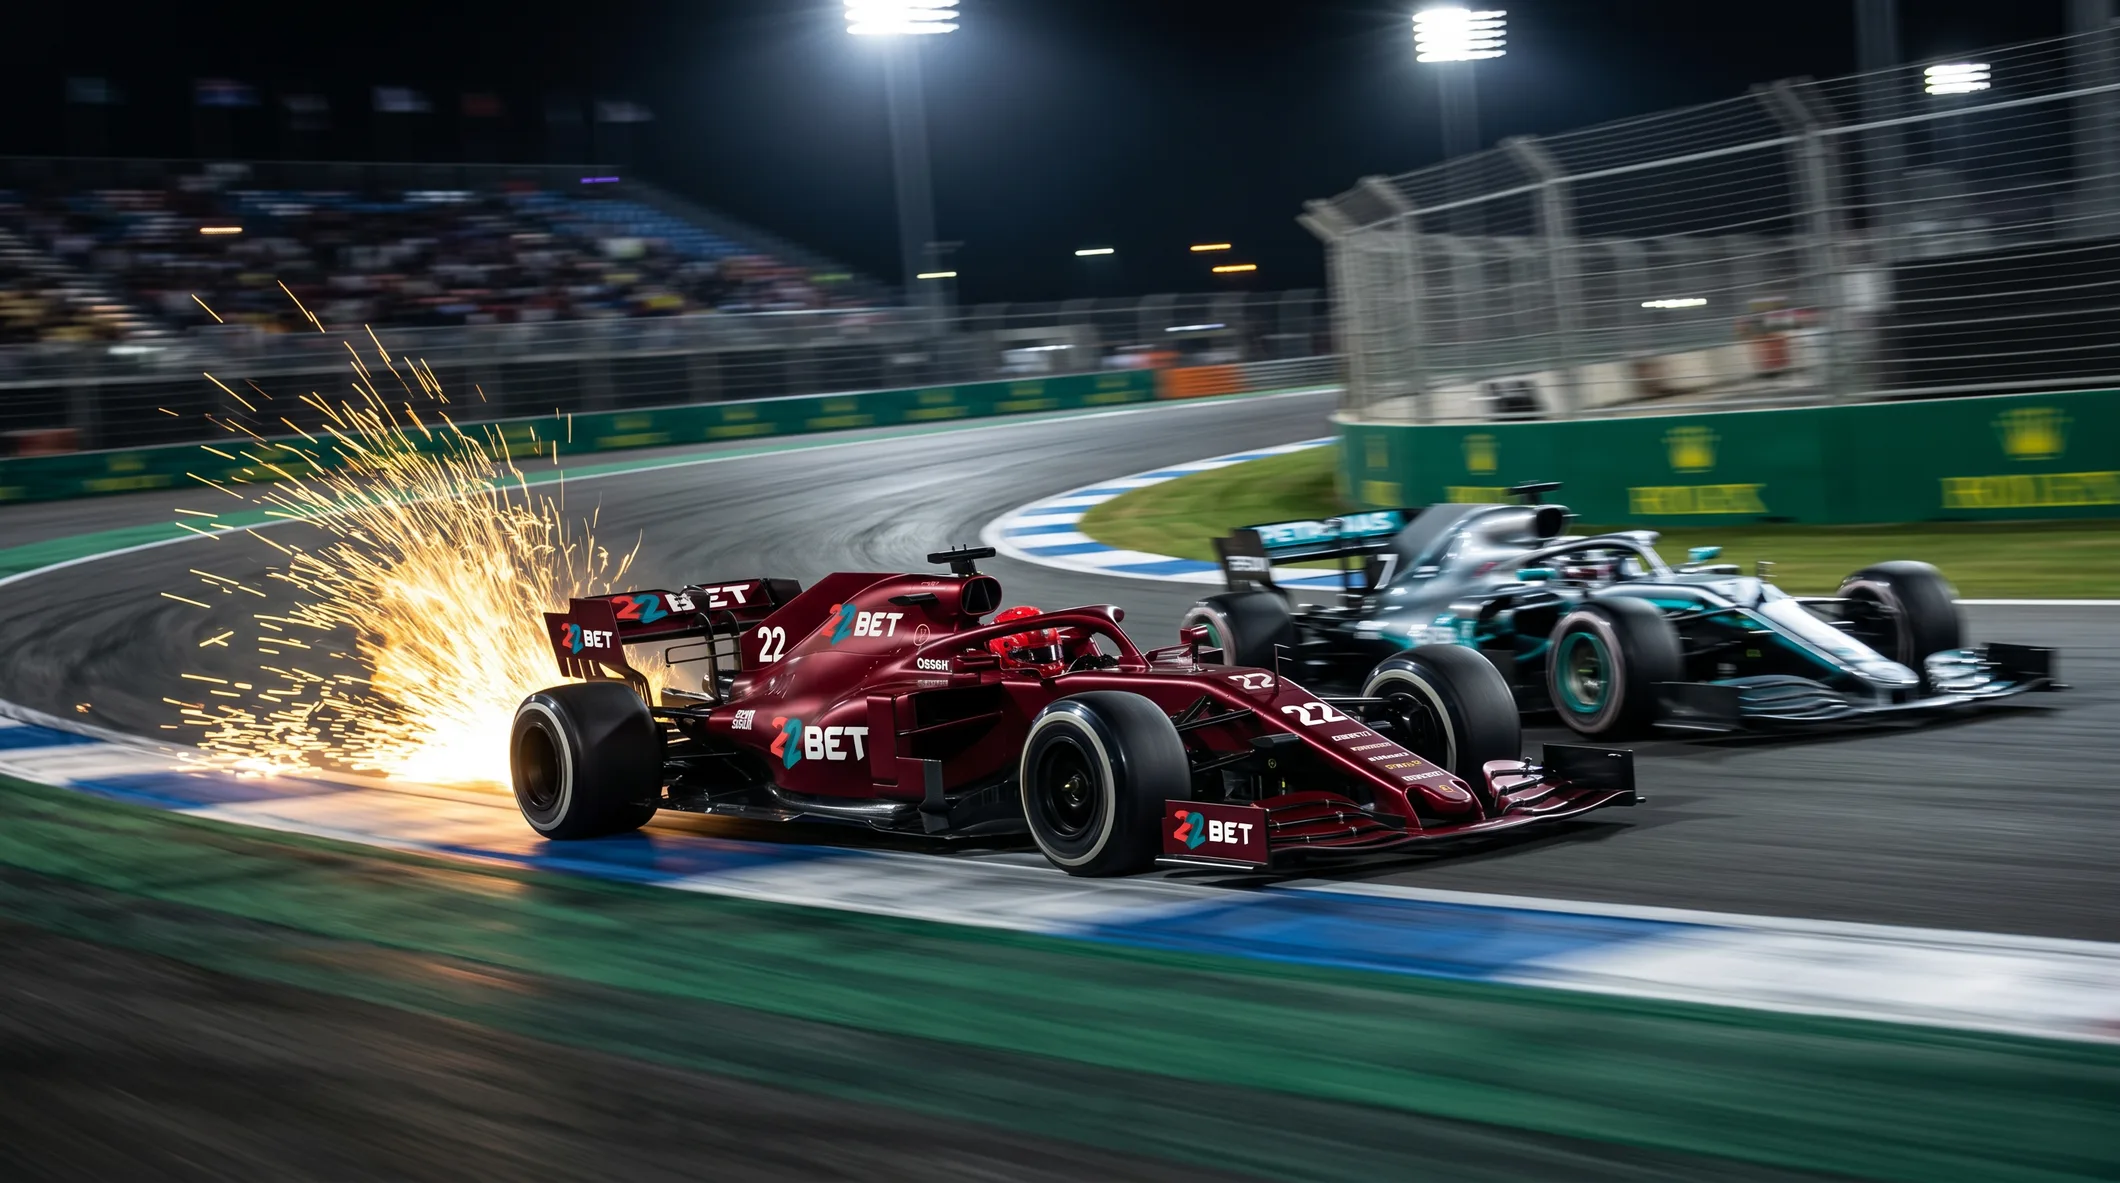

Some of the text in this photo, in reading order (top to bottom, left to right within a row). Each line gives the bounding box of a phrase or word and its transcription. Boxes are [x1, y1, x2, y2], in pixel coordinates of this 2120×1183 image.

[1374, 554, 1398, 590] 7
[561, 622, 613, 655] 22BET
[821, 603, 904, 645] 22BET
[757, 626, 786, 663] 22
[1228, 672, 1281, 690] 22
[1281, 702, 1348, 726] 22
[770, 716, 869, 770] 22BET
[1173, 810, 1253, 850] 22BET
